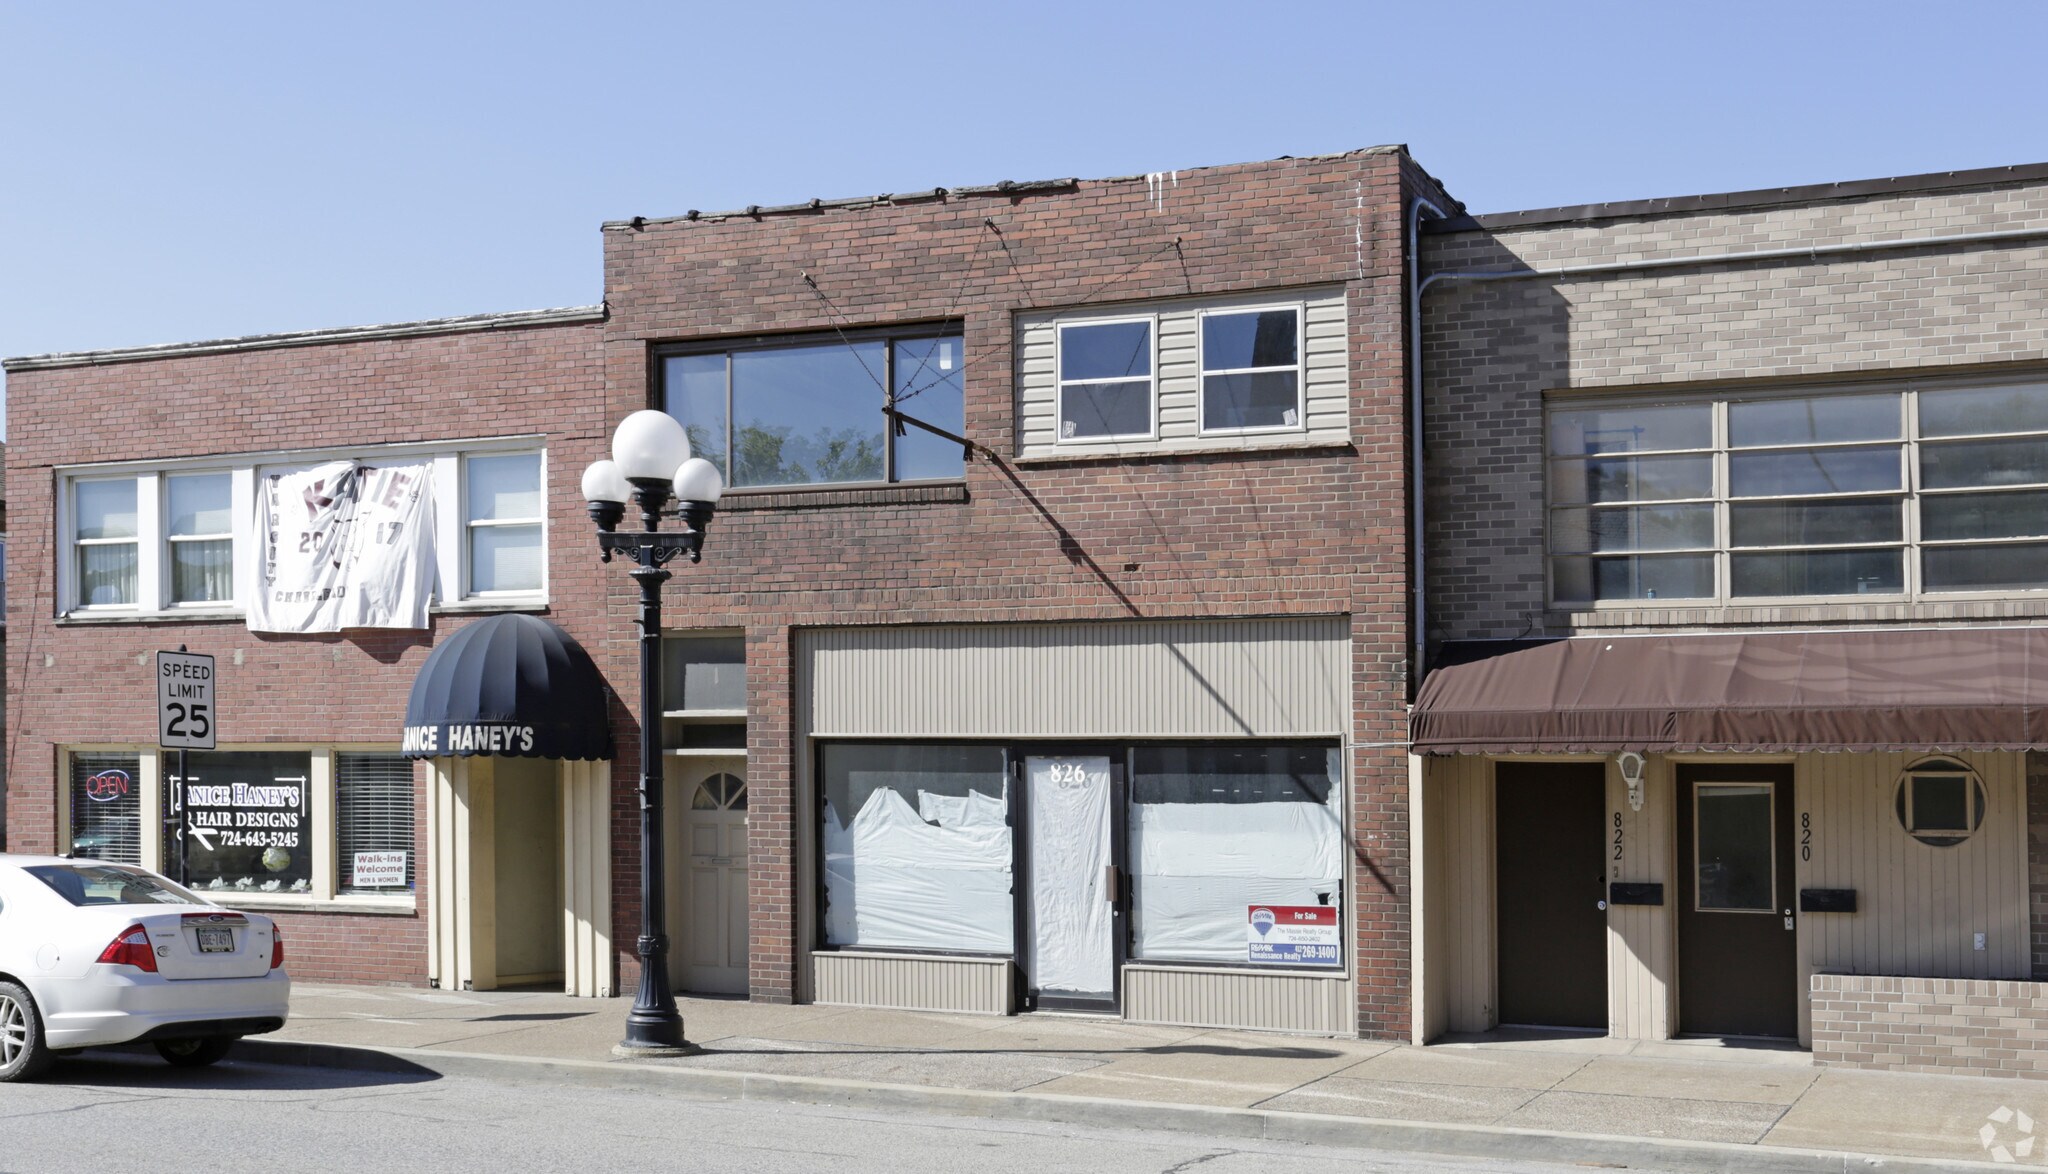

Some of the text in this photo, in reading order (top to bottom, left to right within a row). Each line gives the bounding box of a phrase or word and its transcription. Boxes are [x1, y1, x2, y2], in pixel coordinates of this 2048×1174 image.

[375, 521, 404, 545] 17
[163, 663, 210, 680] SPEED
[168, 683, 205, 699] LIMIT
[166, 702, 210, 738] 25
[403, 725, 534, 752] ANICE HANEY'S
[1050, 763, 1086, 783] 826
[86, 775, 128, 794] OPEN
[231, 782, 300, 808] HANEY'S
[196, 811, 299, 828] HAIR DESIGNS
[220, 831, 299, 847] 724-643-5245
[1613, 812, 1623, 861] 822
[1801, 812, 1811, 862] 820
[357, 854, 403, 863] Walk-ins
[356, 865, 404, 873] Welcome
[1294, 911, 1317, 920] For Sale
[1250, 951, 1301, 962] Renaissance Realty
[1302, 945, 1336, 959] 269-1400
